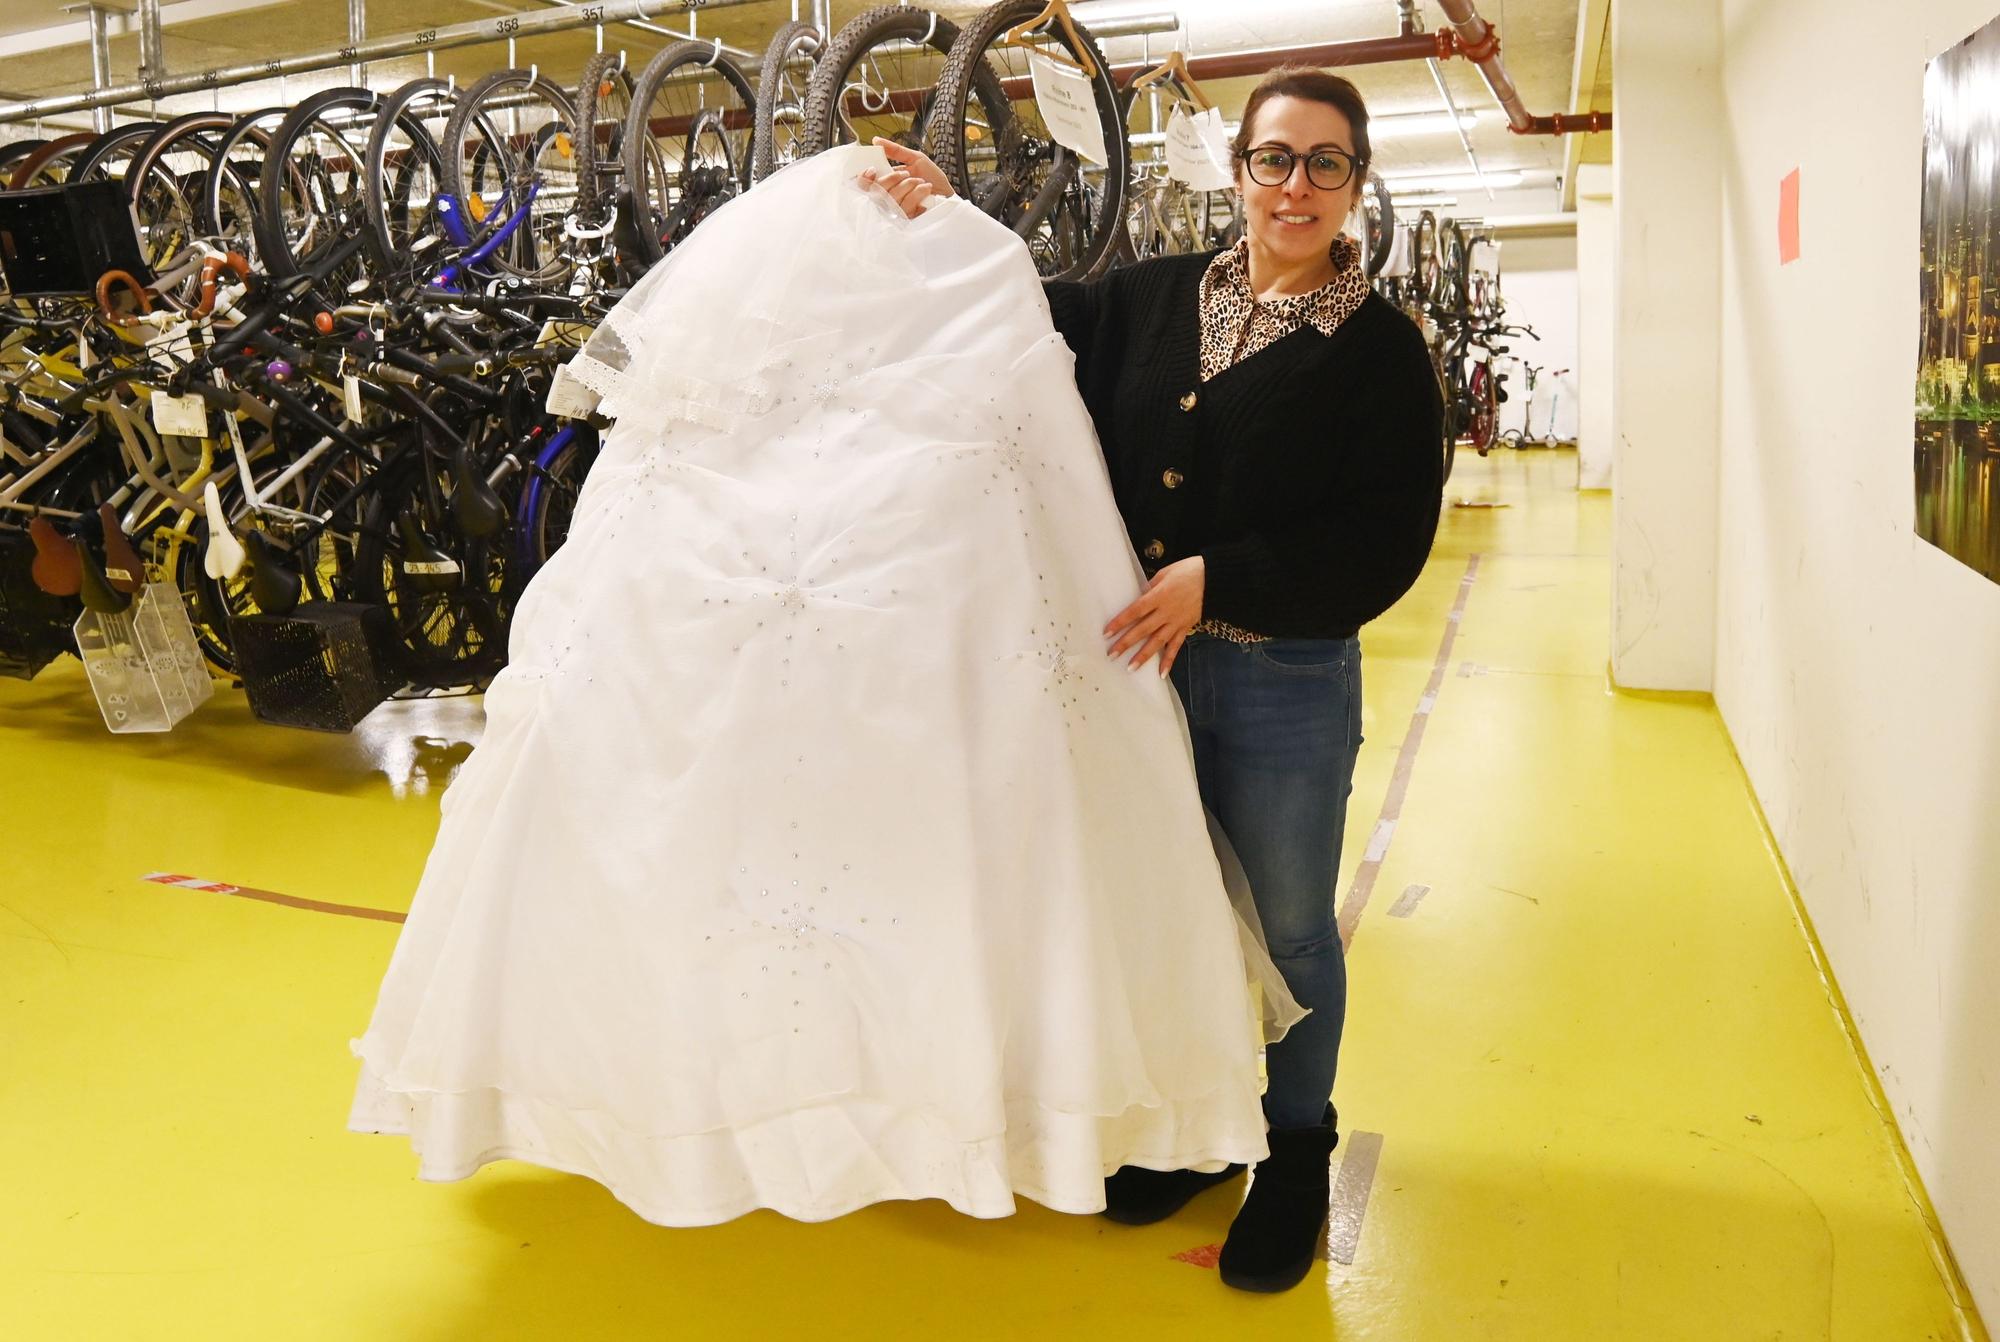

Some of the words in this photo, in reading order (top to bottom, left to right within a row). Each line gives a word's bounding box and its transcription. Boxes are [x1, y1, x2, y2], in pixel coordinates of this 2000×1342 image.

[582, 6, 604, 21] 357
[496, 18, 519, 34] 358
[415, 30, 436, 45] 359
[338, 46, 357, 60] 360
[265, 59, 283, 73] 361
[202, 71, 218, 83] 362
